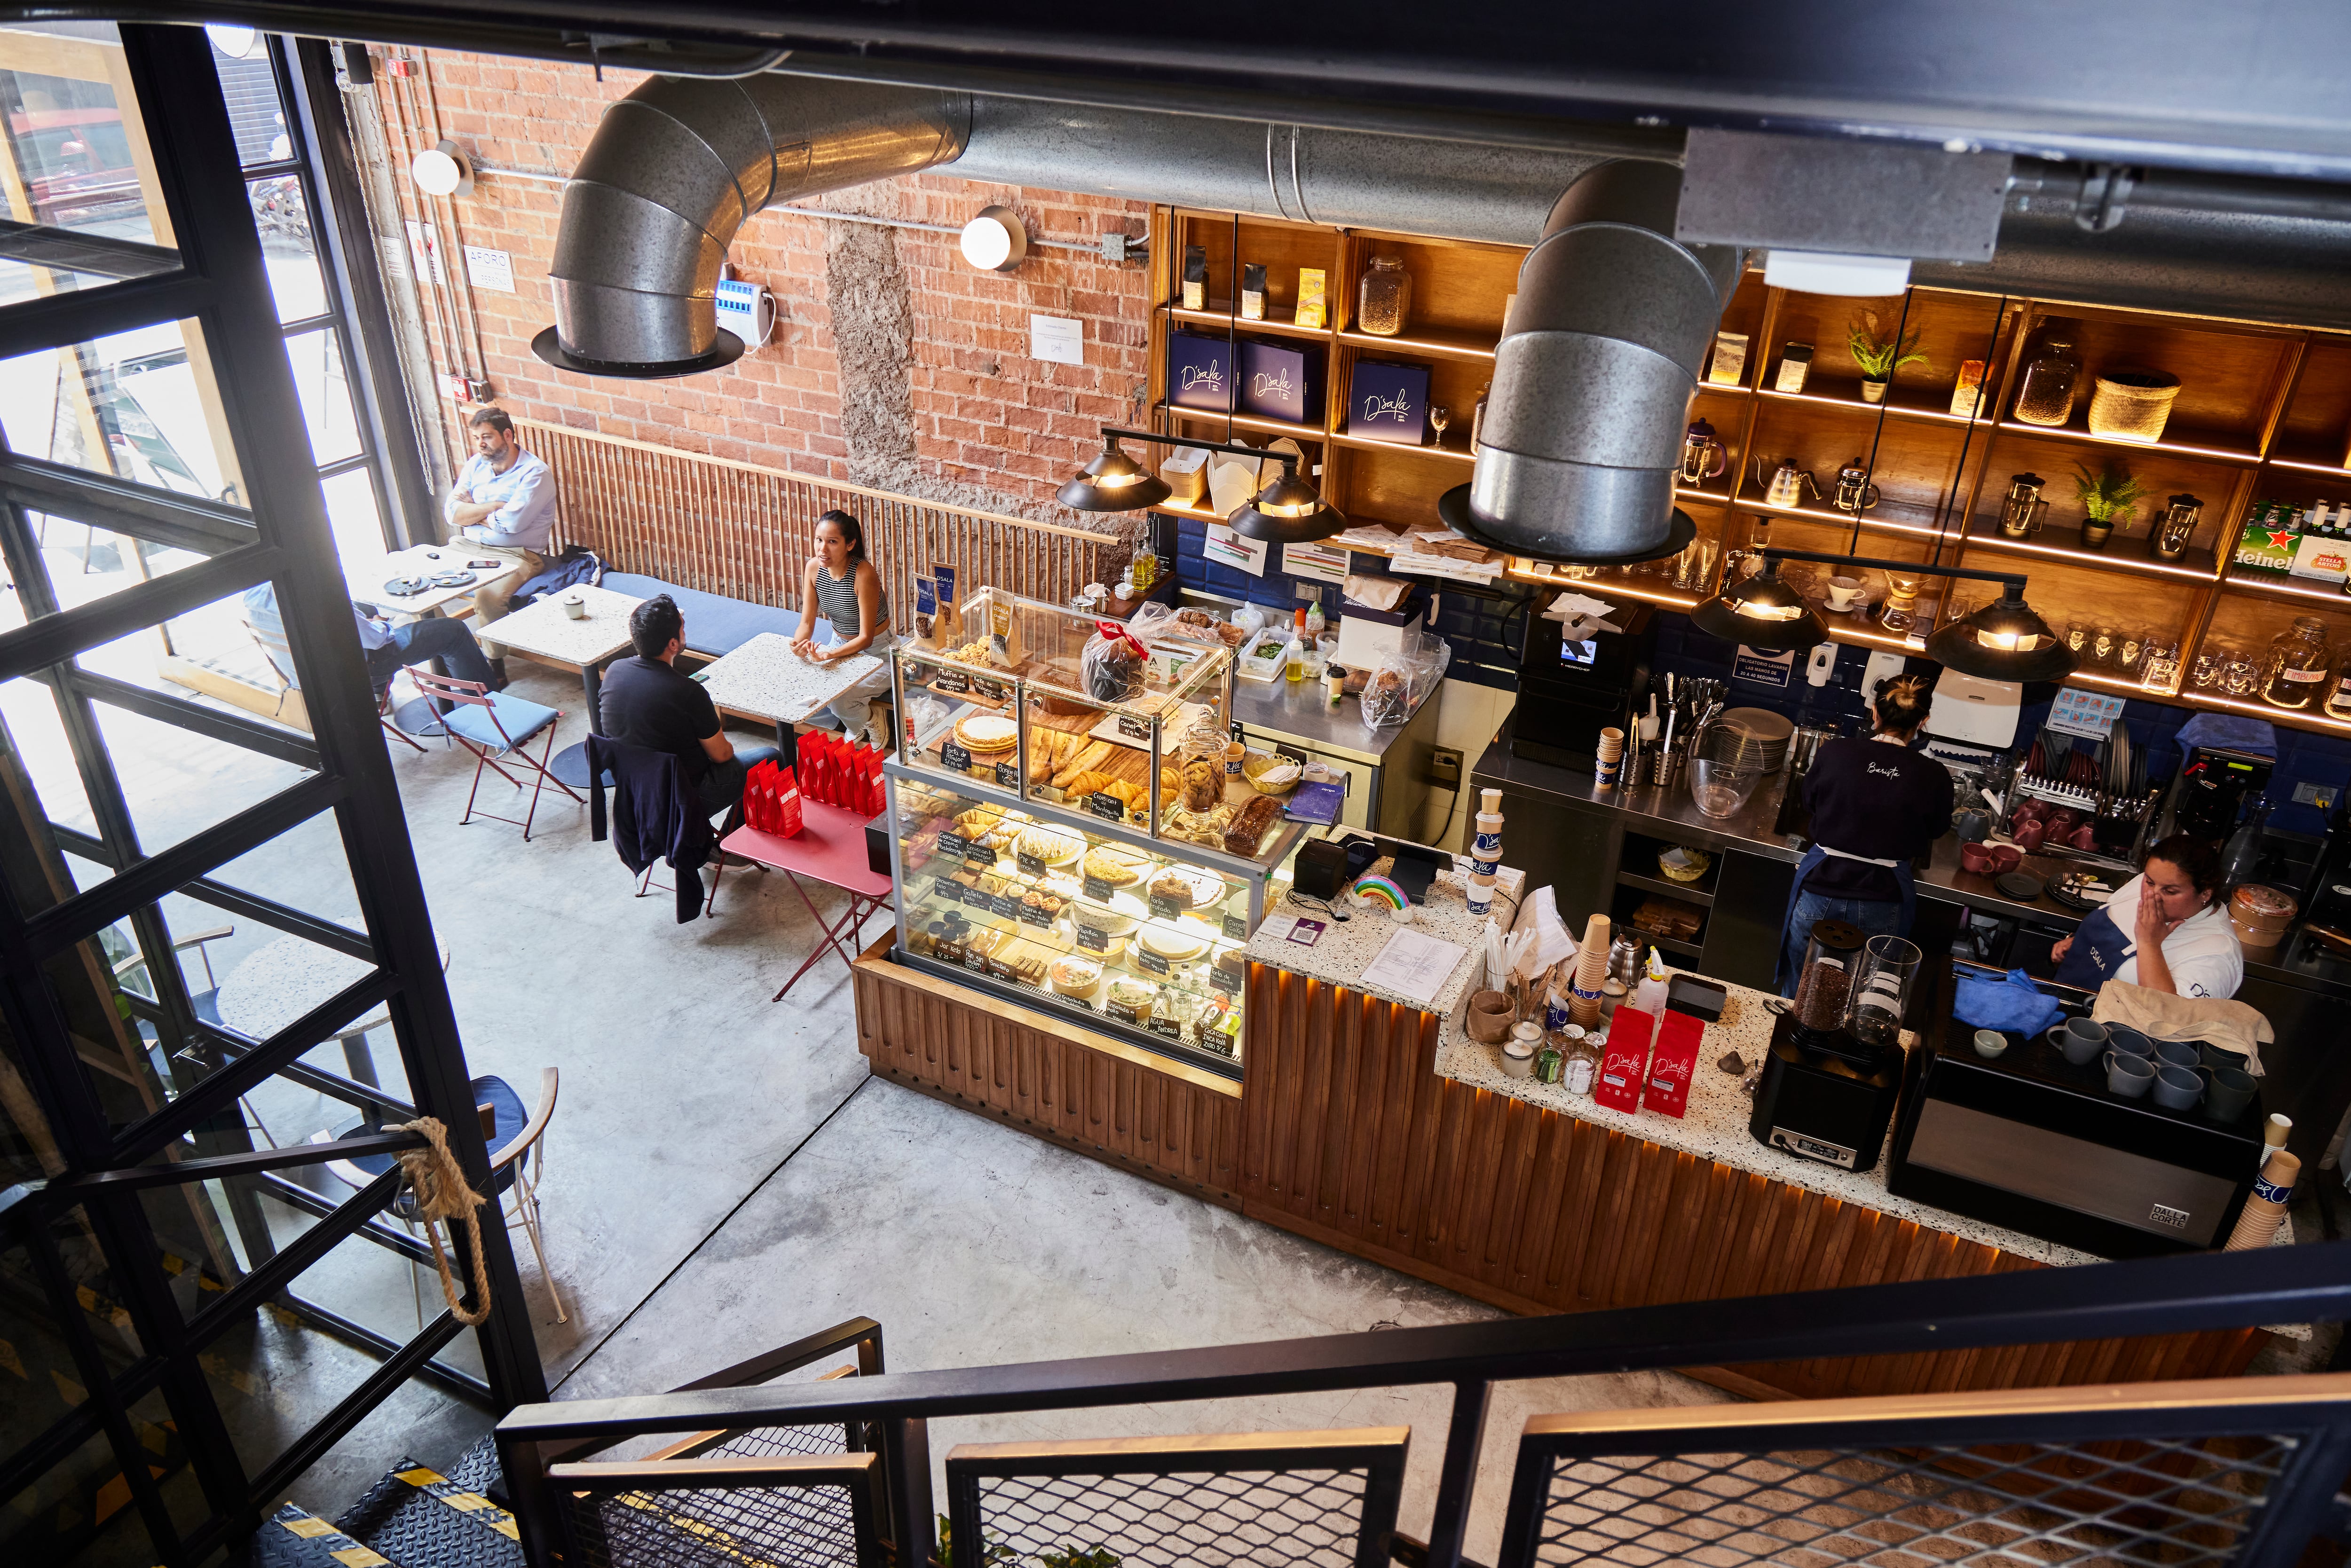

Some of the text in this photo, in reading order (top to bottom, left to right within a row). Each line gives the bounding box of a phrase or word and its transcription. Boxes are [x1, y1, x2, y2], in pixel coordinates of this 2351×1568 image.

[471, 252, 506, 267] AFORO
[1181, 359, 1223, 390] D'sala
[1254, 368, 1292, 397] D'sala
[1365, 388, 1411, 421] D'sala
[1739, 657, 1767, 667] OBLIGATORIO
[938, 668, 957, 679] Muffin
[1757, 674, 1781, 683] SEGUNDOS
[937, 677, 965, 688] Arandanos
[974, 676, 985, 685] Keke
[1120, 720, 1136, 729] Canel
[947, 745, 959, 756] Torta
[946, 753, 964, 762] Alfajor
[1867, 762, 1900, 780] Barista
[1094, 792, 1117, 805] Croissant
[1092, 802, 1120, 817] Mantequilla
[939, 832, 962, 844] Croissant
[943, 840, 958, 848] Crema
[966, 844, 991, 856] Croissant
[972, 851, 991, 860] manjar
[1019, 853, 1028, 864] Pye
[936, 876, 956, 888] Brownie
[963, 888, 983, 899] Galleta
[992, 897, 1006, 906] Muffin
[1151, 896, 1164, 905] Torta
[1022, 905, 1037, 914] Muffin
[1150, 902, 1171, 914] trufada
[1228, 920, 1246, 930] Carrot
[1229, 926, 1243, 935] Cake
[965, 949, 974, 960] Pan
[1139, 950, 1166, 964] Cheesecake
[2090, 946, 2106, 971] D'SALA
[965, 958, 982, 969] Gluten
[1211, 968, 1223, 977] Torta
[1062, 994, 1085, 1006] Ensalada
[1107, 1001, 1129, 1014] Ensalada
[1202, 1033, 1215, 1043] INCA
[1606, 1053, 1641, 1073] D'sala
[1654, 1058, 1689, 1078] D'sala
[2154, 1206, 2186, 1221] DALLA
[2151, 1213, 2185, 1228] CORTE
